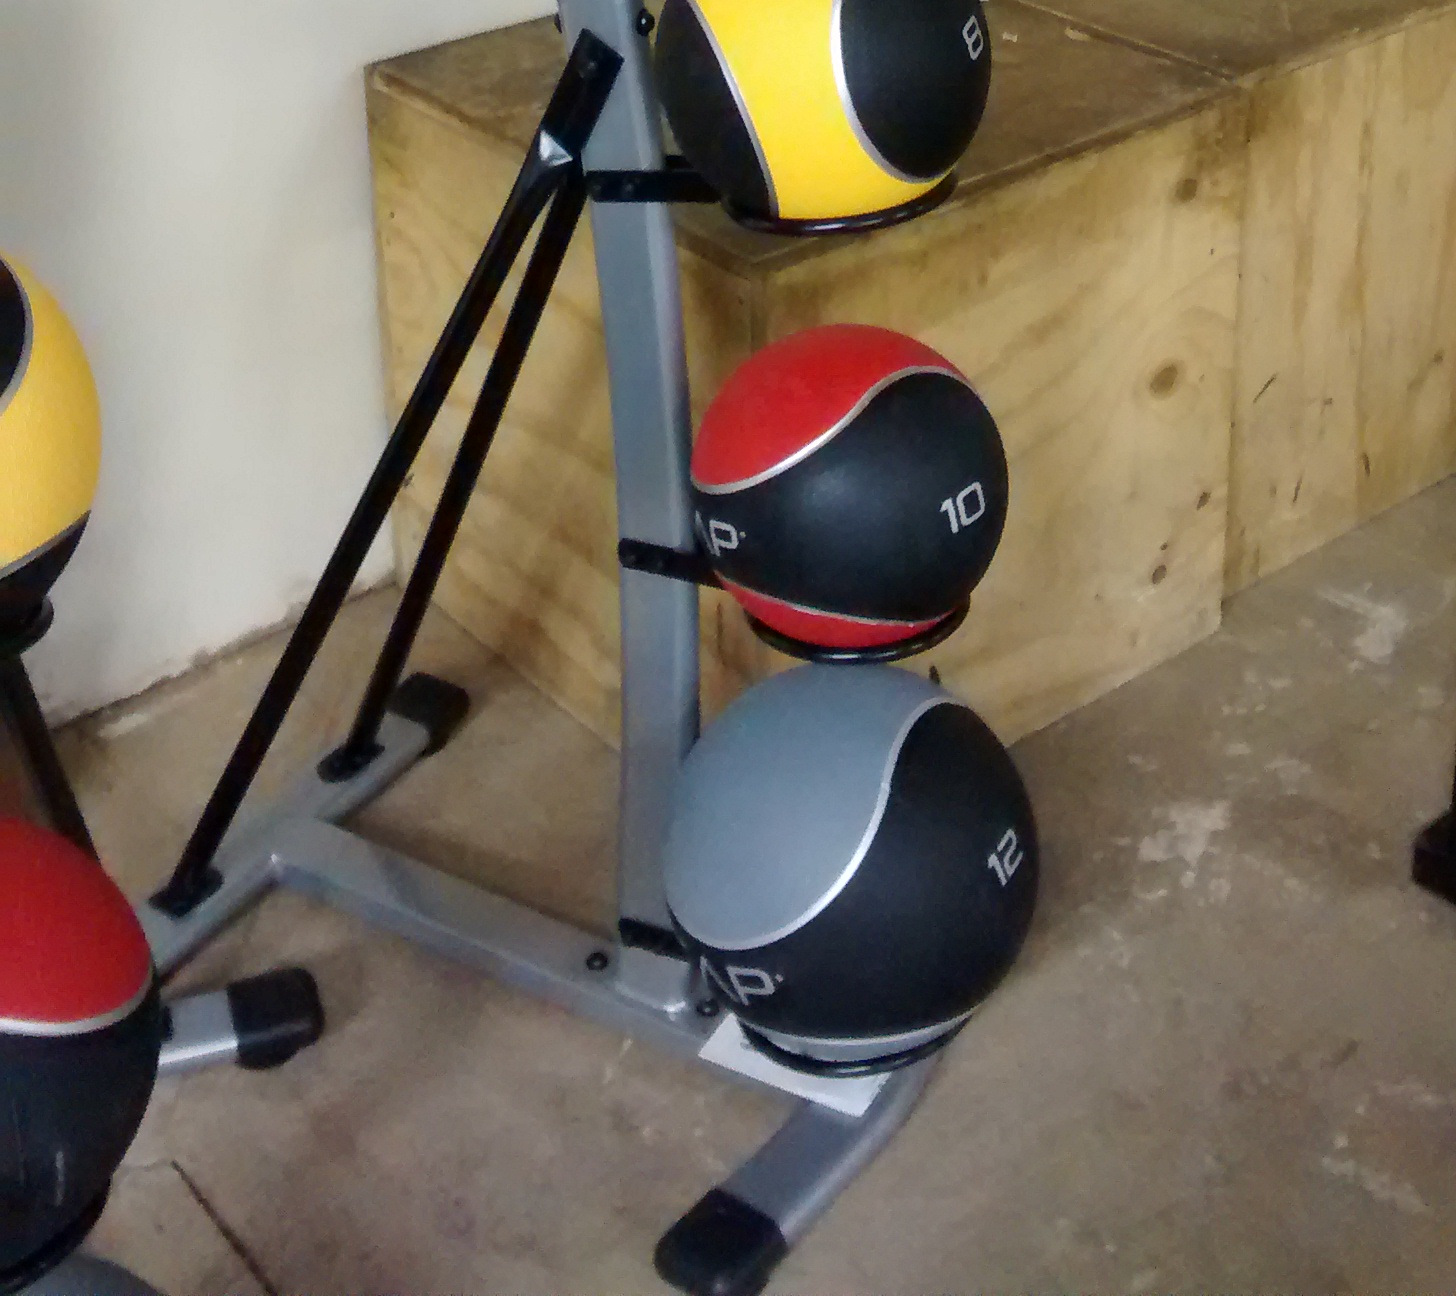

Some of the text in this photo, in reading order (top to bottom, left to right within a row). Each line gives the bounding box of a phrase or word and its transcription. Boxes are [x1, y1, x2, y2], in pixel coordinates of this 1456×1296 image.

[962, 15, 984, 61] 8
[939, 481, 986, 534] 10
[987, 828, 1024, 887] 12
